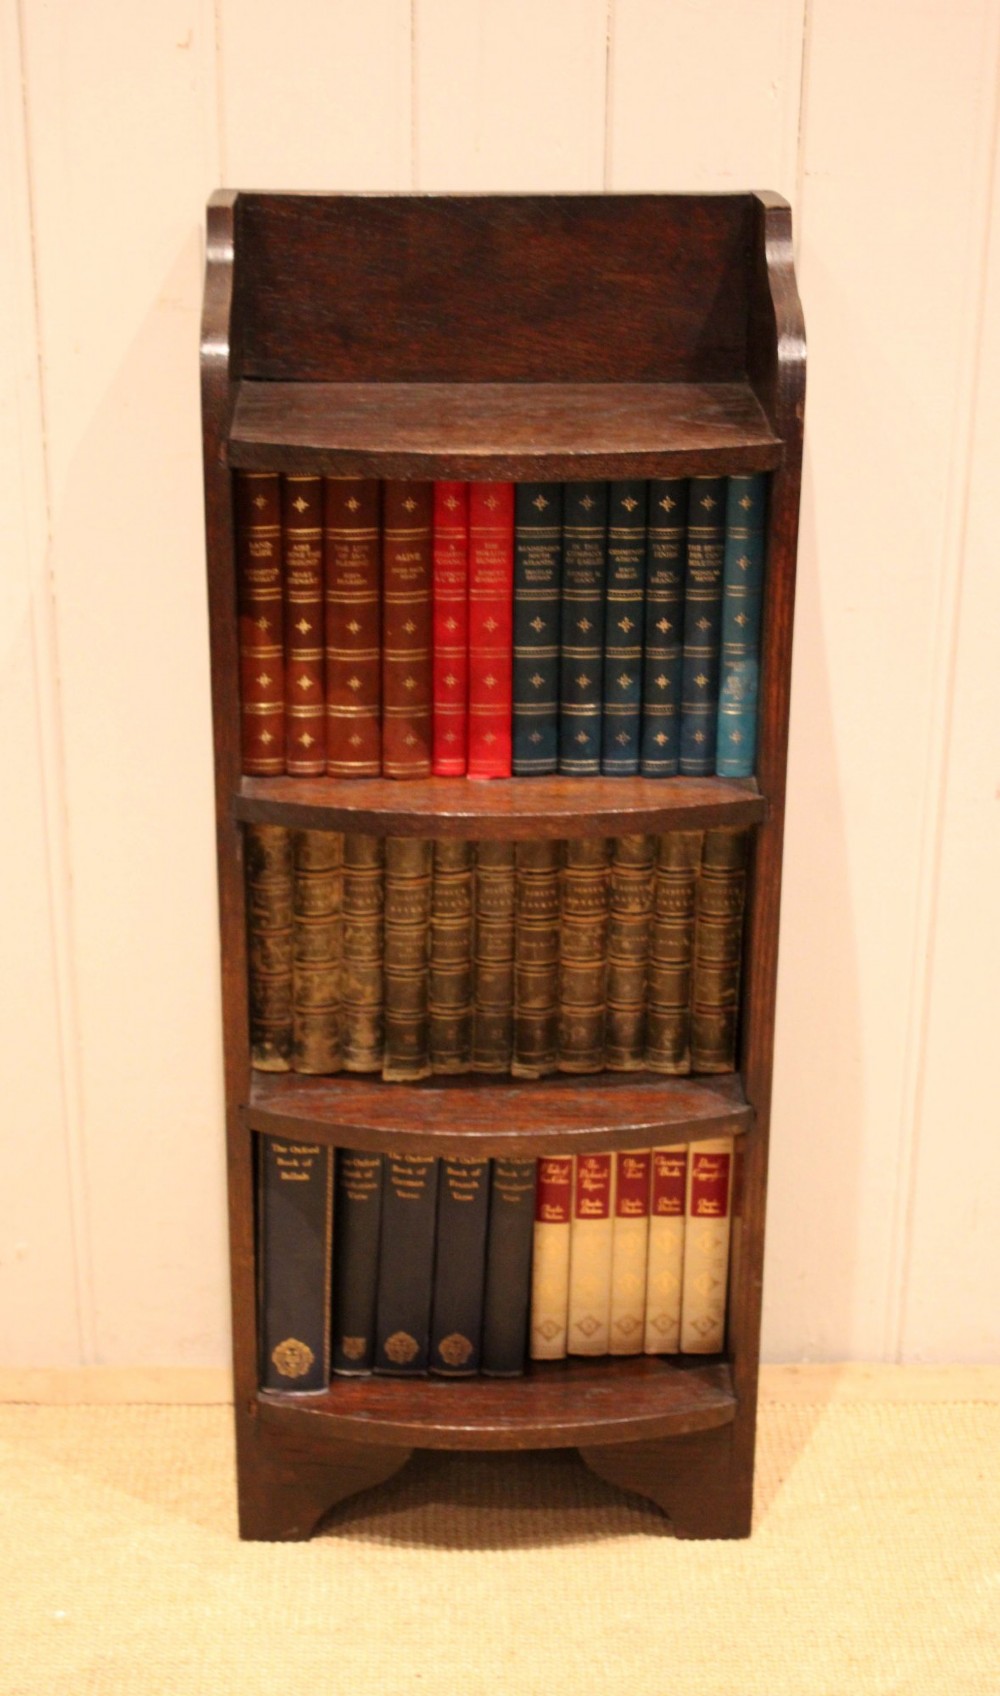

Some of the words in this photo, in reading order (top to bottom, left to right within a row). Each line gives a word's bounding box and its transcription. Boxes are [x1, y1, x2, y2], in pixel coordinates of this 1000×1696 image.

[271, 1142, 289, 1153] The
[290, 1145, 321, 1155] Oxford
[276, 1157, 299, 1167] Book
